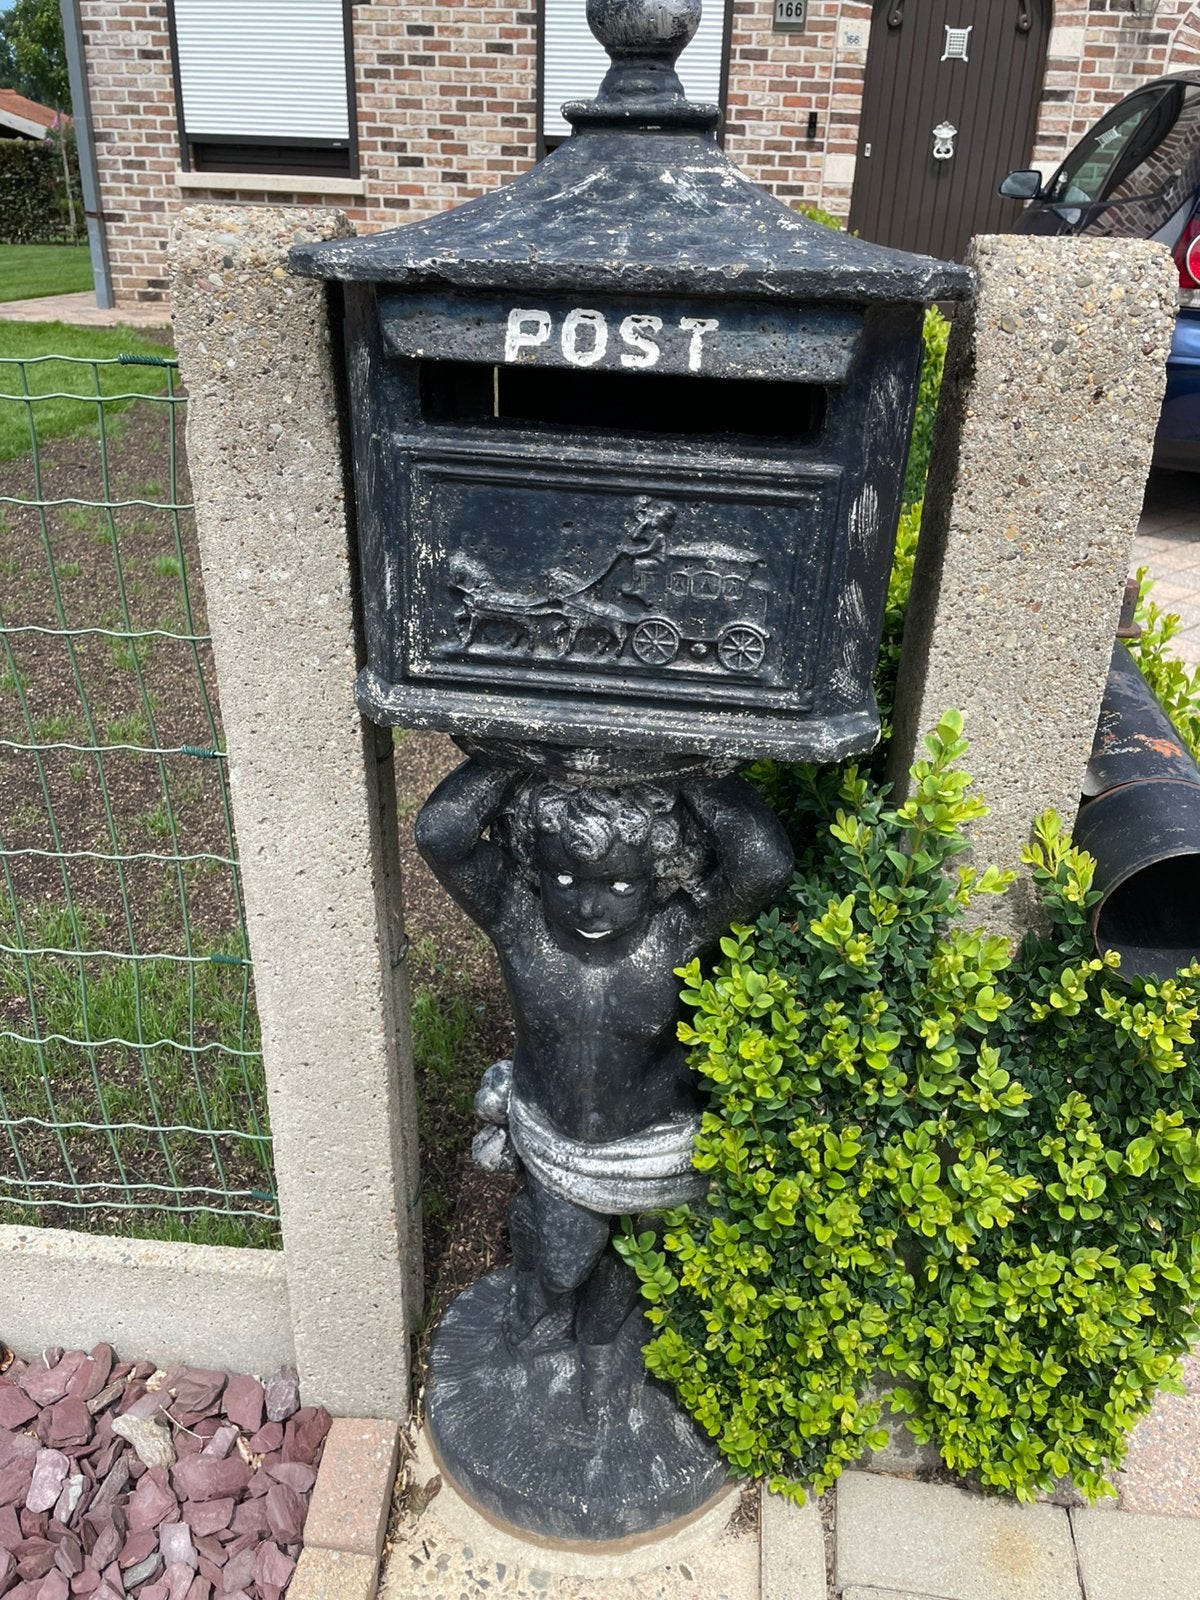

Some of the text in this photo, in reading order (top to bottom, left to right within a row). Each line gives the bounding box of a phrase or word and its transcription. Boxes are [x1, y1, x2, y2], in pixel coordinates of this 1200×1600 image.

[778, 2, 803, 17] 166
[846, 35, 860, 44] 166
[505, 308, 720, 372] POST
